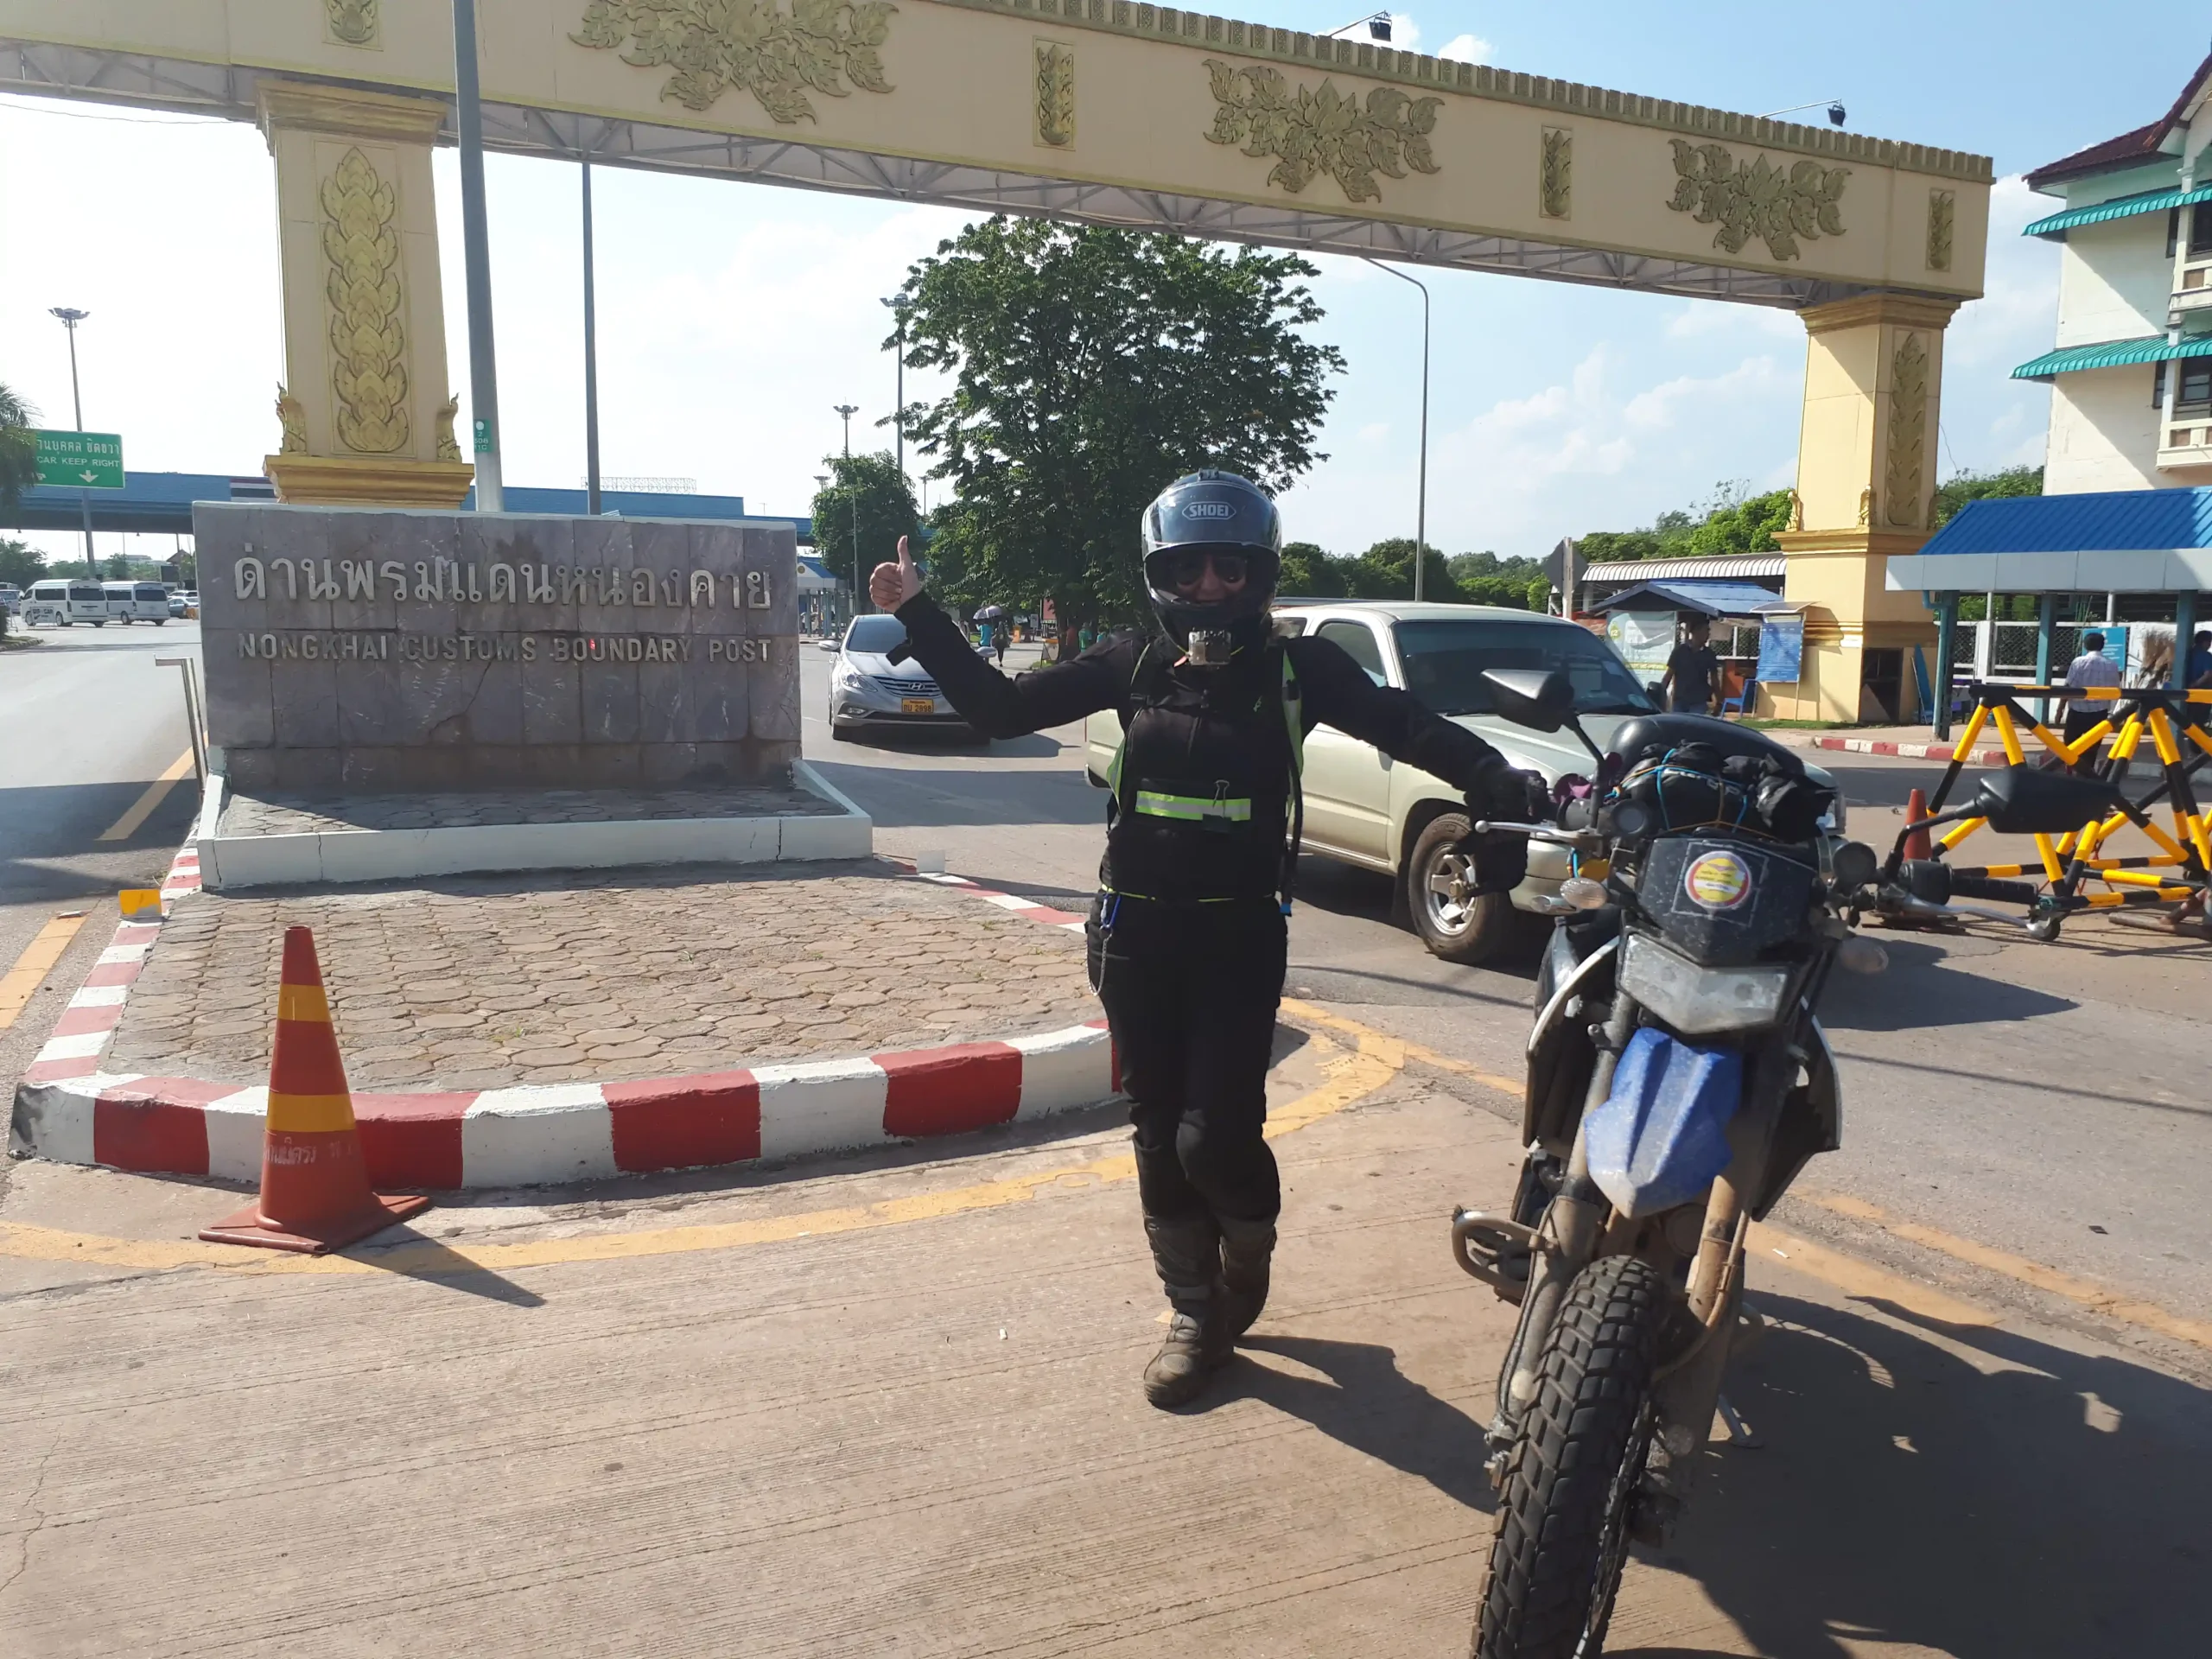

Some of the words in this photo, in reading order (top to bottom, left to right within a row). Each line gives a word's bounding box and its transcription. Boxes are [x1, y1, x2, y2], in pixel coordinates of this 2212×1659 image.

[36, 456, 58, 465] CAR
[61, 457, 87, 466] KEEP
[92, 459, 121, 468] RIGHT
[1189, 504, 1230, 518] SHOEI
[234, 542, 772, 609] ด่านพรมแดนหนองคาย
[238, 632, 388, 660] NONGKHAI
[404, 634, 537, 662] CUSTOMS
[553, 637, 691, 663] BOUNDARY
[709, 639, 772, 663] POST
